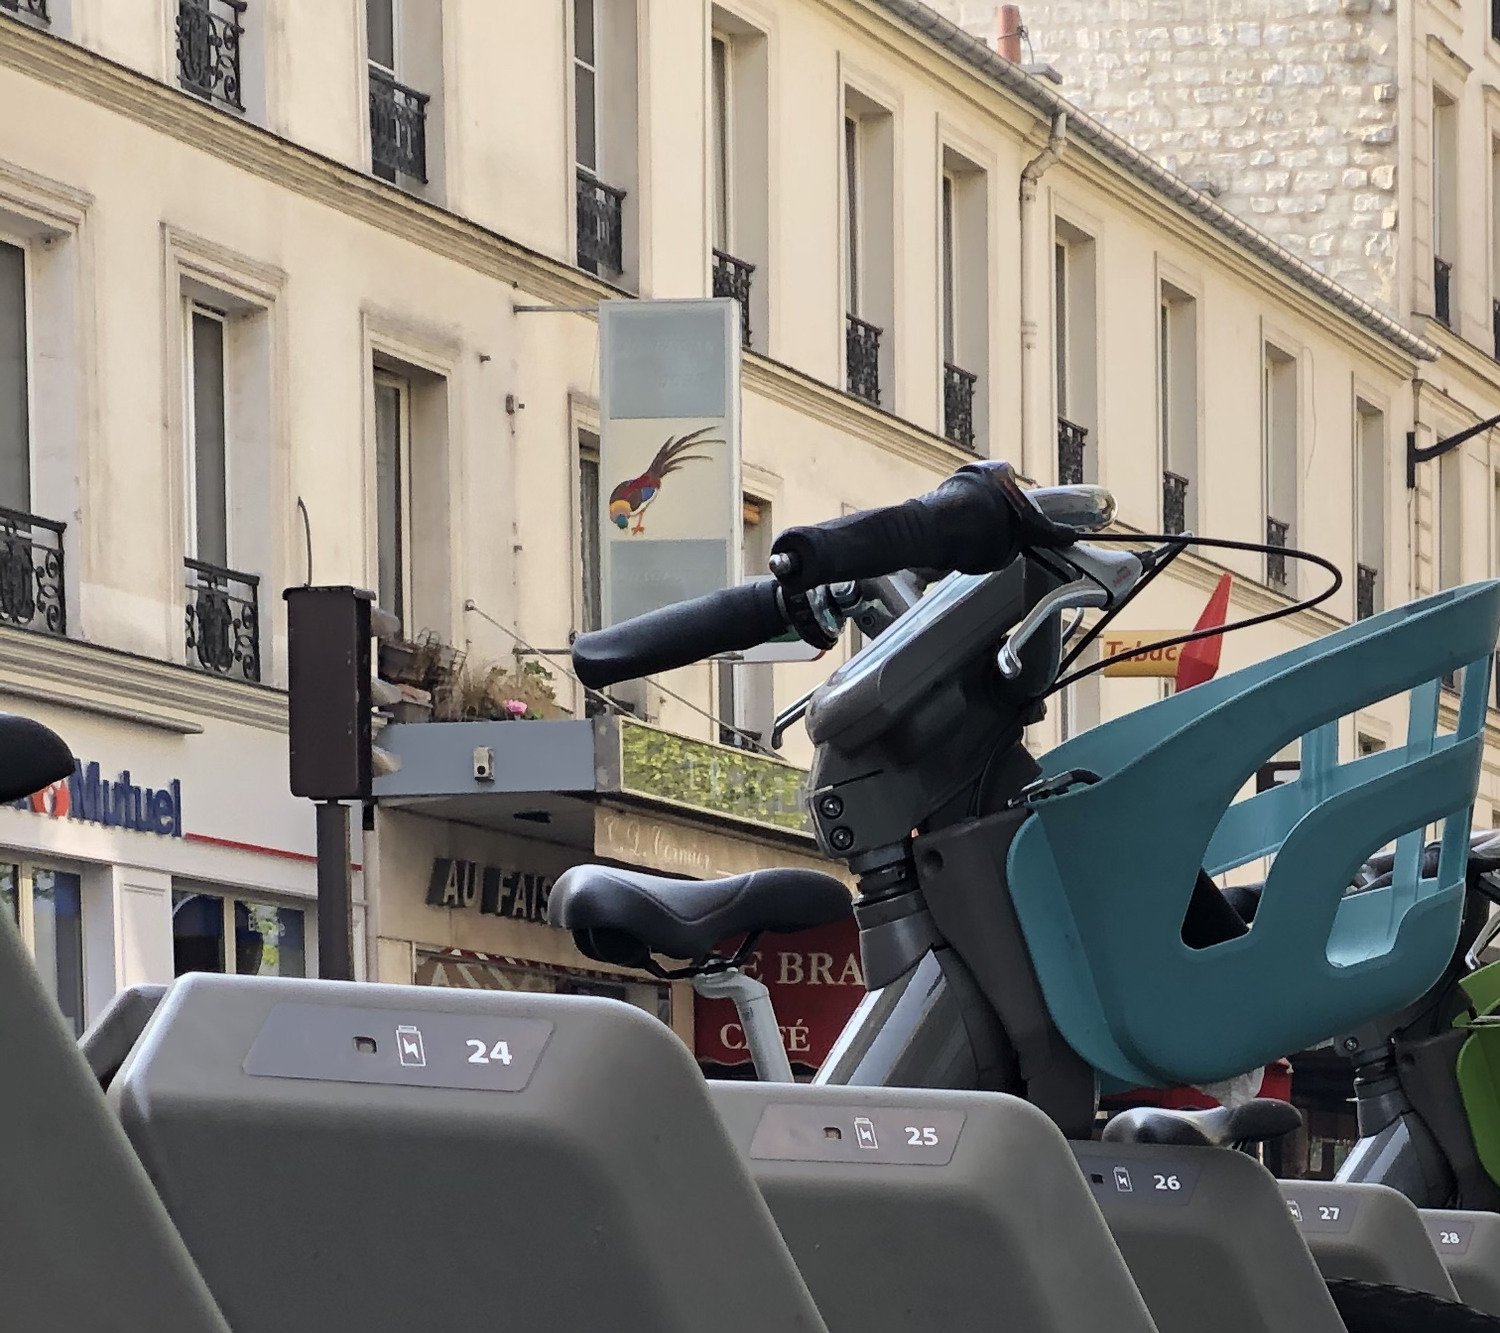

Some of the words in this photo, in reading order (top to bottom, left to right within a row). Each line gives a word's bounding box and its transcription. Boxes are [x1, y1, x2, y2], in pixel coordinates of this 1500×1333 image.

[69, 758, 181, 838] Mutuel
[432, 858, 478, 908] AU
[720, 1018, 810, 1052] CFÉ
[465, 1039, 513, 1065] 24
[904, 1126, 939, 1146] 25
[1153, 1174, 1181, 1190] 26
[1318, 1206, 1340, 1221] 27
[1440, 1231, 1460, 1246] 28
